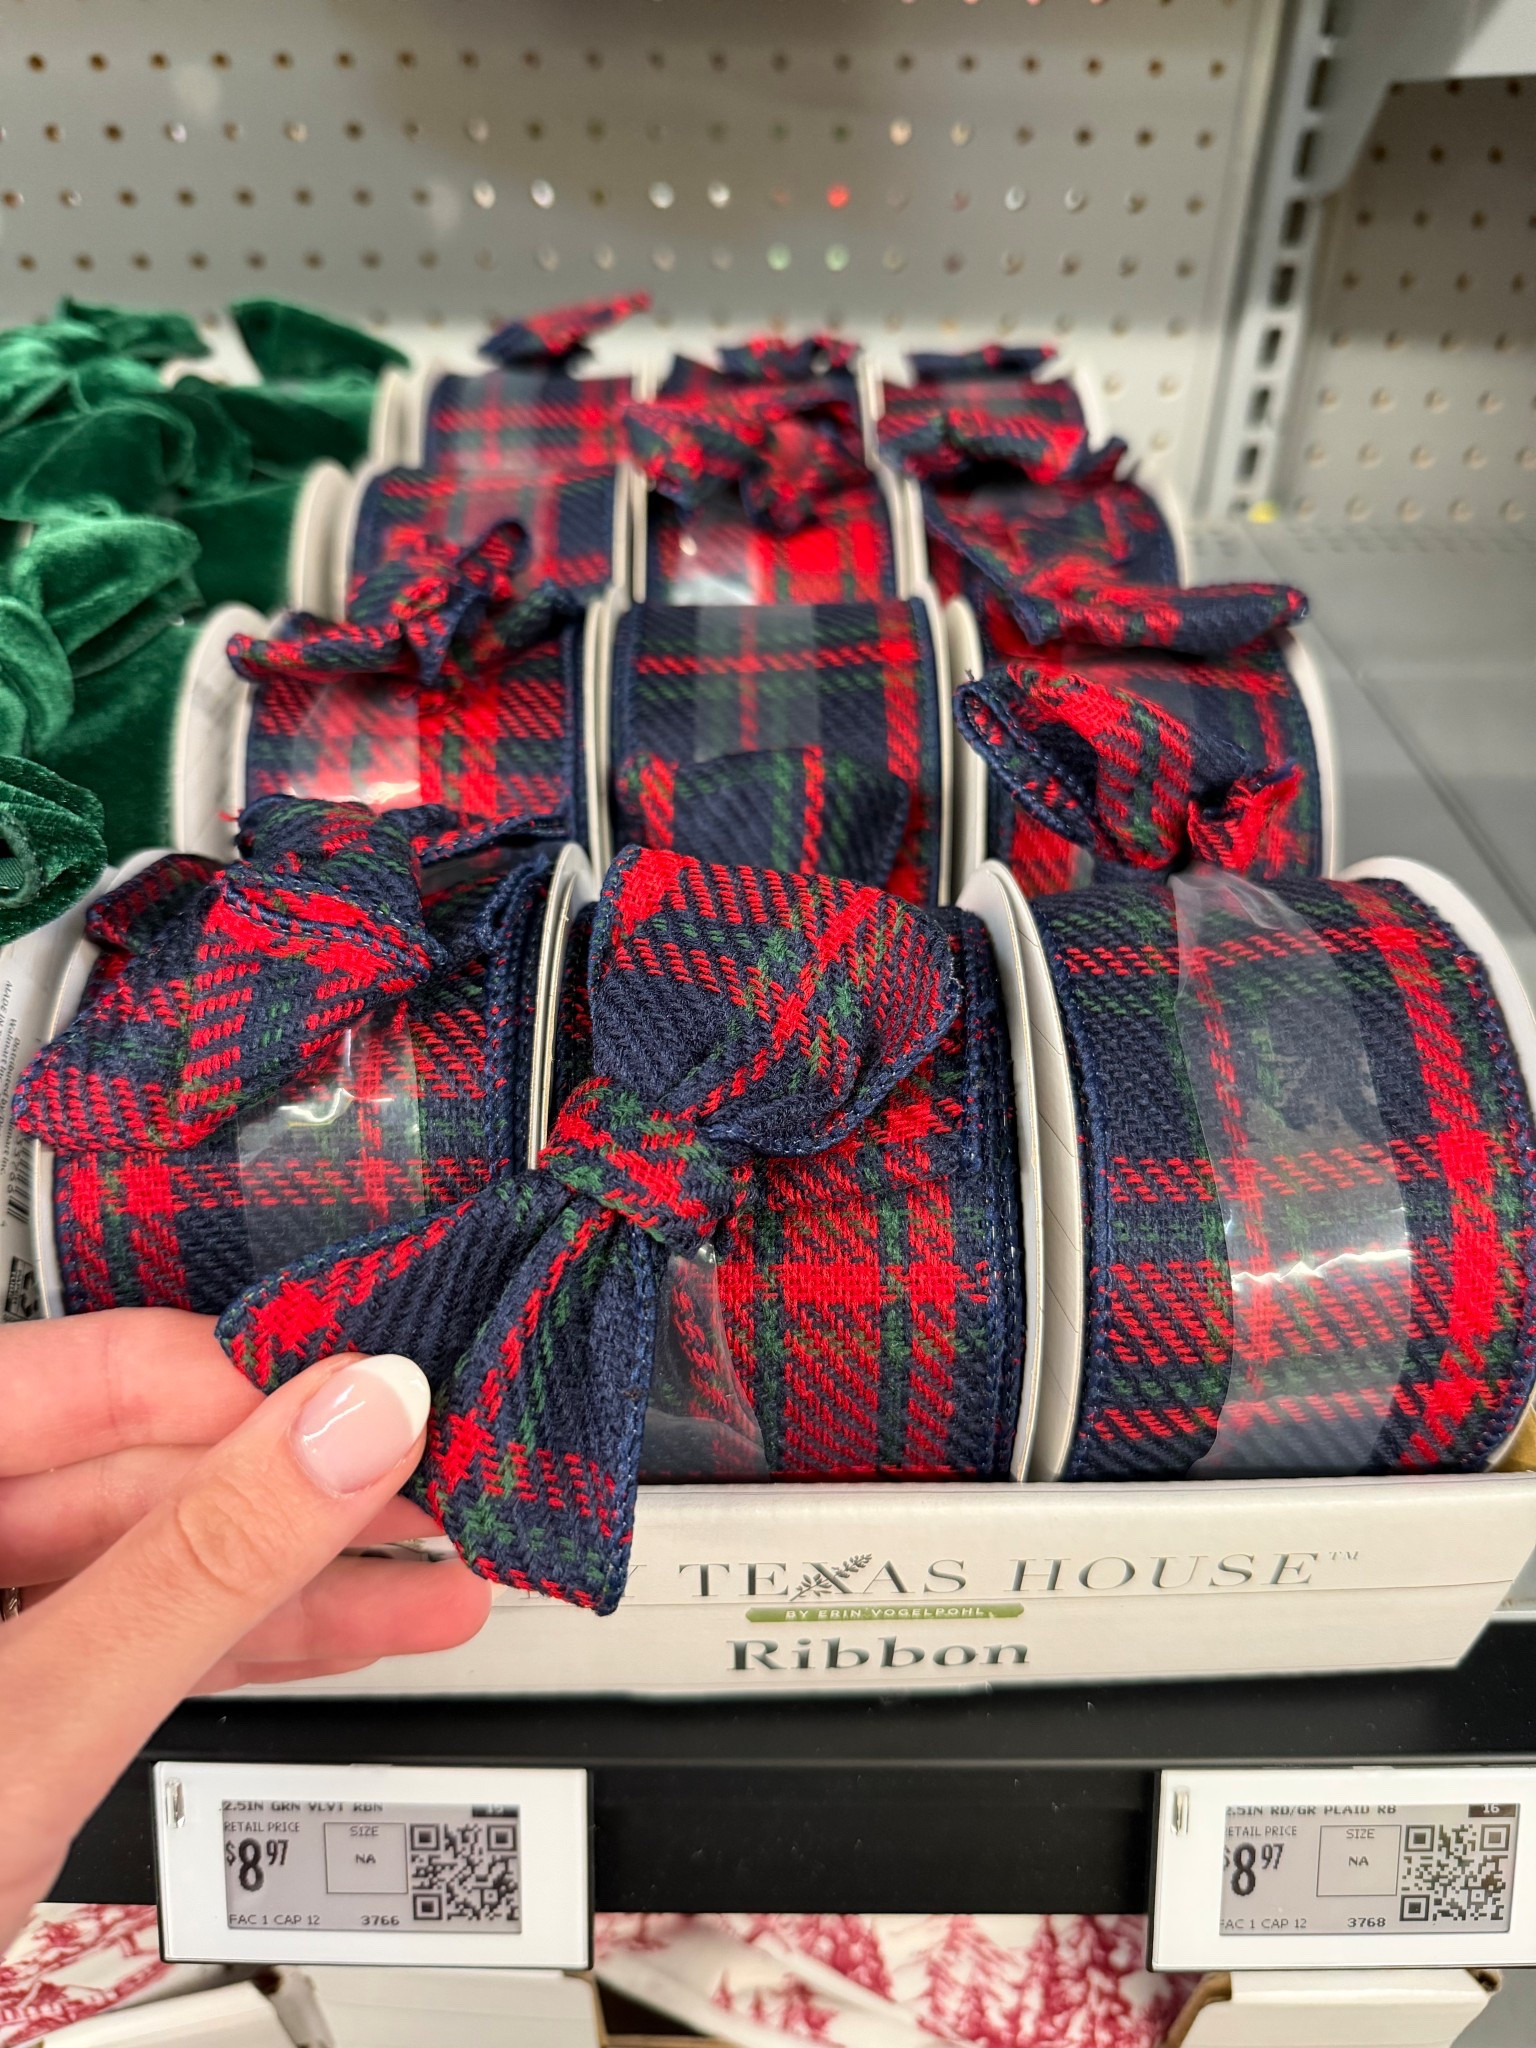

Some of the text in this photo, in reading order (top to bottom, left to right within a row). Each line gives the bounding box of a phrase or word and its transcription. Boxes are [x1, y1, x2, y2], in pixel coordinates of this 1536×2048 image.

[679, 1558, 968, 1598] TEXAS
[785, 1606, 986, 1621] BY ERIN VOGELPOHL
[726, 1635, 1030, 1671] Ribbon
[1482, 1802, 1500, 1814] 16
[223, 1821, 300, 1833] RETAIL PRICE
[349, 1825, 380, 1837] SIZE
[1225, 1825, 1298, 1837] ETAIL PRICE
[1345, 1828, 1376, 1839] SIZE
[355, 1853, 377, 1865] NA
[1347, 1855, 1369, 1867] NA
[228, 1914, 400, 1927] FAC 1 CAP 12 3766
[1249, 1918, 1256, 1930] 1
[1260, 1918, 1289, 1930] CAP
[1294, 1918, 1308, 1930] 12
[1347, 1917, 1387, 1929] 3768
